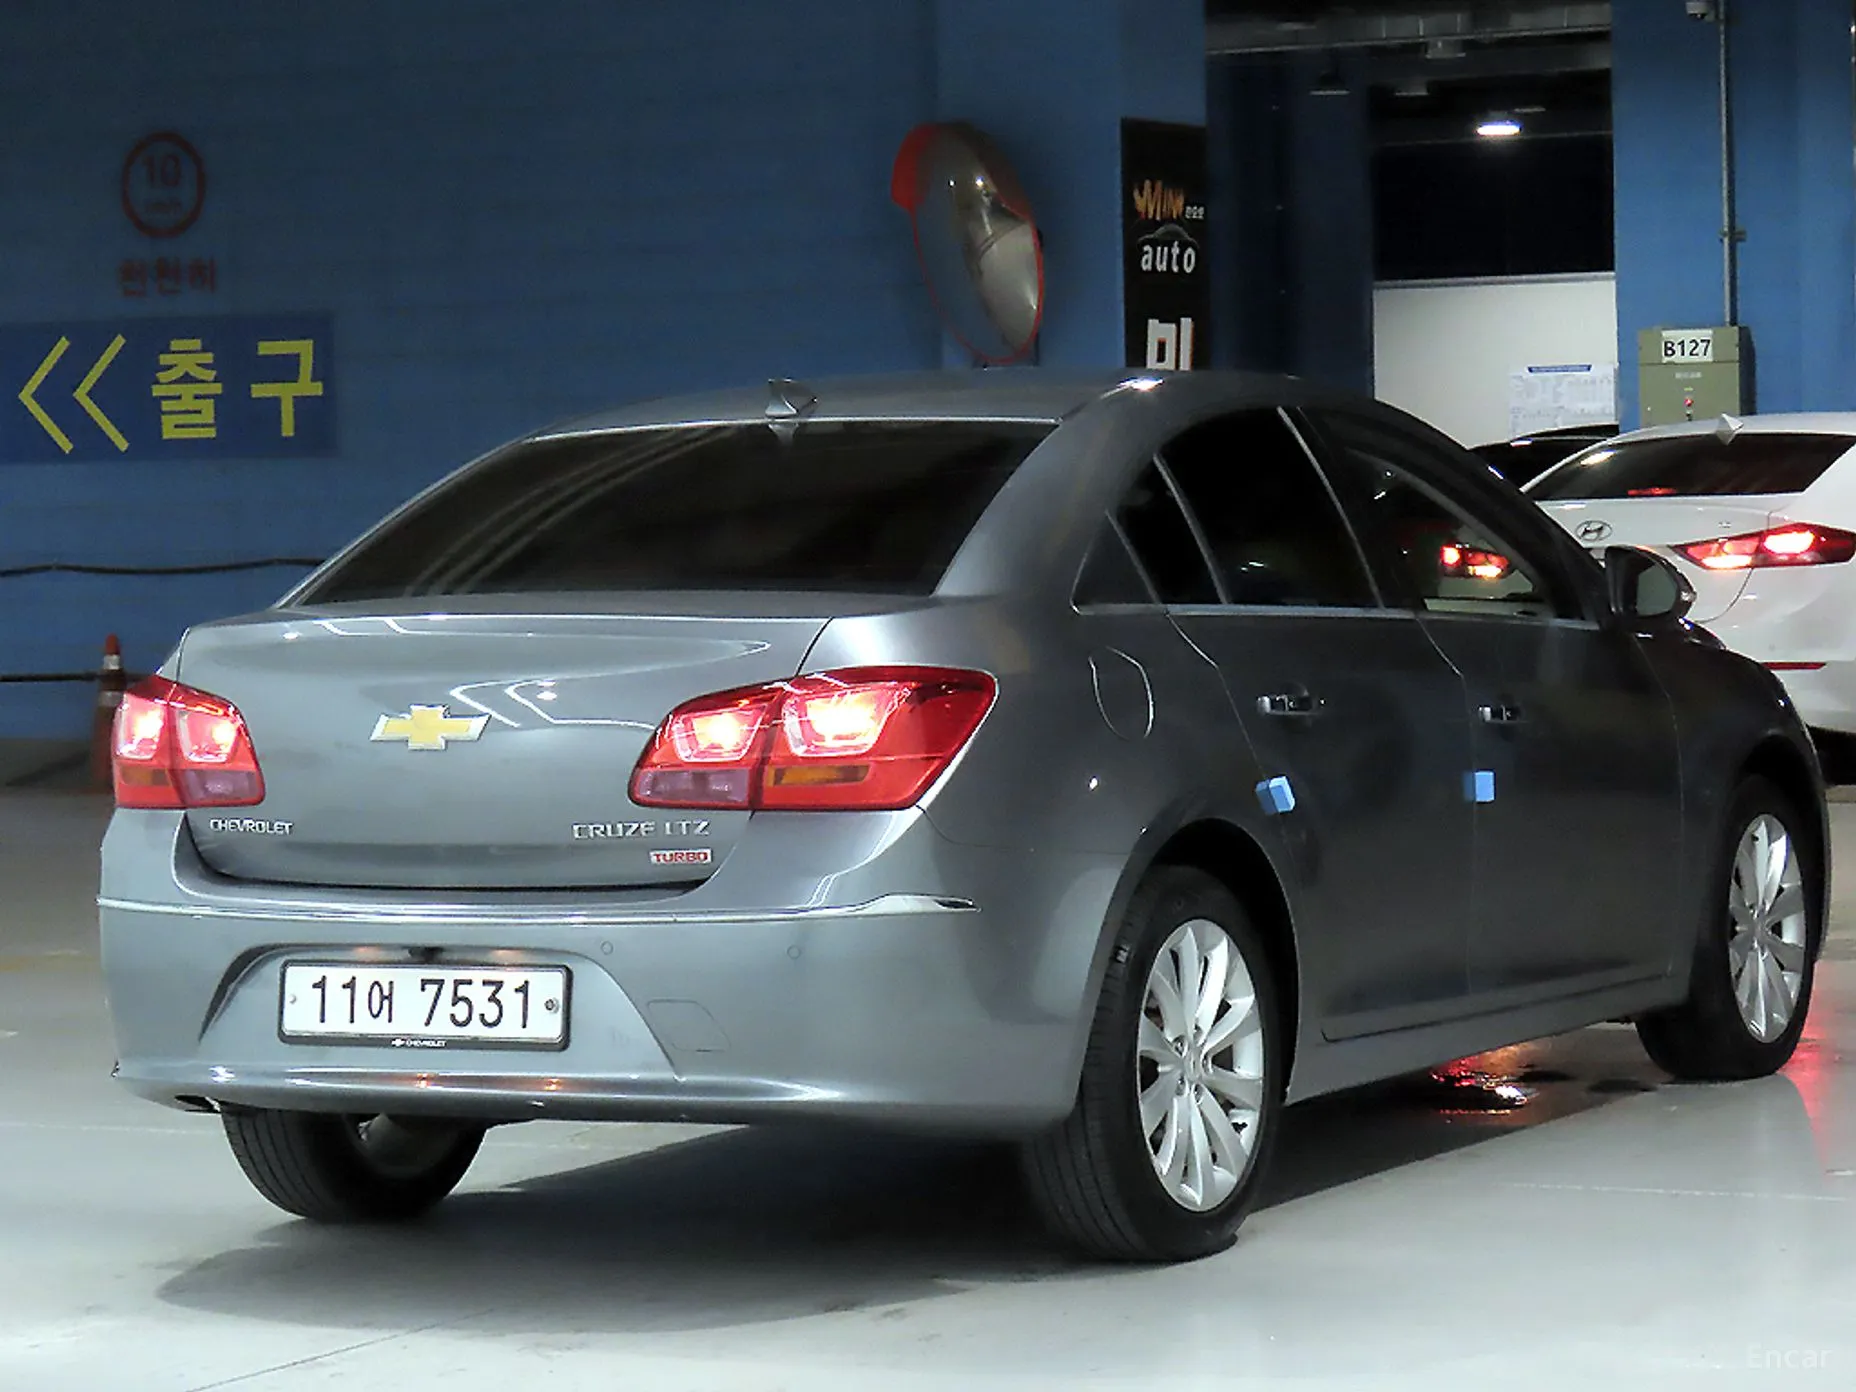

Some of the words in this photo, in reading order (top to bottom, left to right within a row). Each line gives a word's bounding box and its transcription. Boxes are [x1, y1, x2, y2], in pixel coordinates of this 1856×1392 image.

[141, 154, 182, 187] 10
[1141, 240, 1197, 273] auto
[1663, 338, 1711, 358] B127
[152, 338, 324, 440] 출구
[209, 818, 294, 835] CHEVROLET
[572, 820, 657, 839] CRUZE
[653, 851, 709, 864] TURBO
[311, 974, 394, 1025] 11어
[419, 978, 531, 1030] 7531
